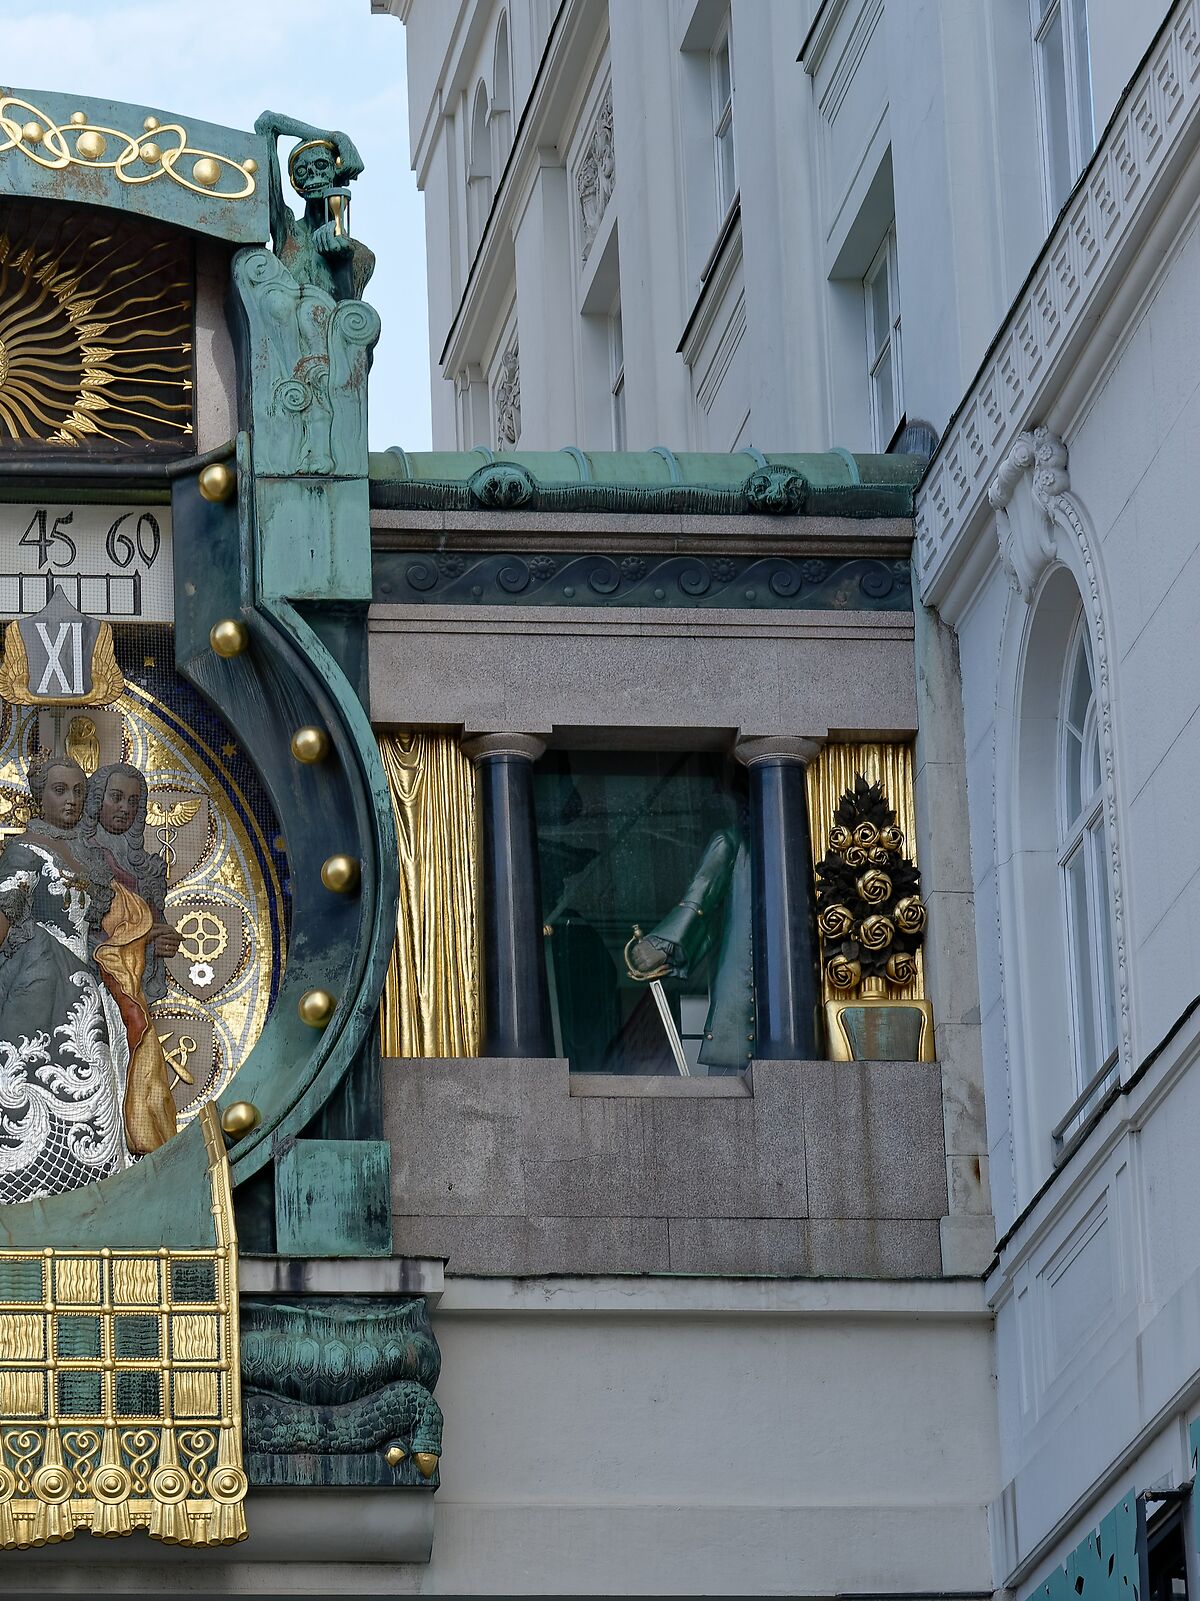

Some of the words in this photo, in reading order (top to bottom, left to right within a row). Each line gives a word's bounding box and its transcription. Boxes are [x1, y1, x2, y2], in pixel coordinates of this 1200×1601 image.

[19, 509, 77, 569] 45
[105, 511, 161, 569] 60
[34, 622, 85, 694] XI
